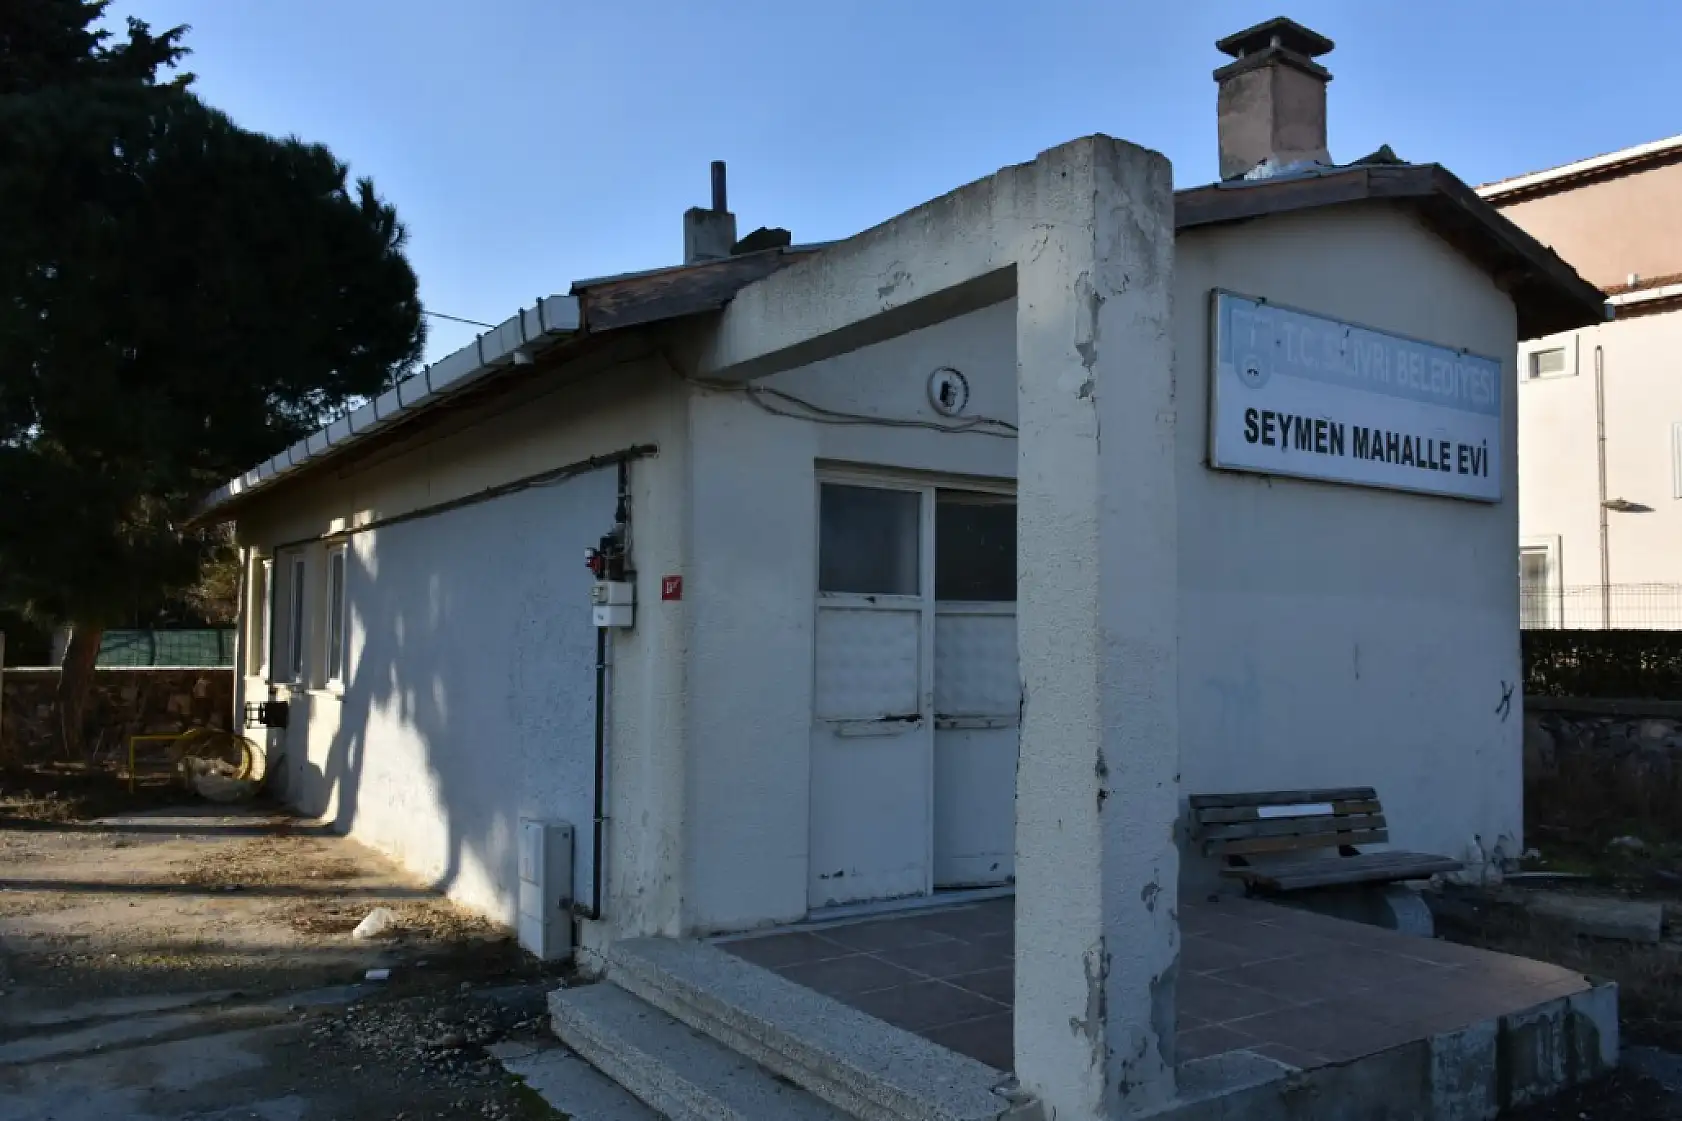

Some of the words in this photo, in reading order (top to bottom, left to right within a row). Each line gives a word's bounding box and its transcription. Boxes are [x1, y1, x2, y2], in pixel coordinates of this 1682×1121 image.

[1322, 332, 1390, 384] SLİVRİ
[1244, 407, 1346, 457] SEYMEN
[1353, 425, 1451, 473] MAHALLE
[1457, 438, 1489, 478] EVİ
